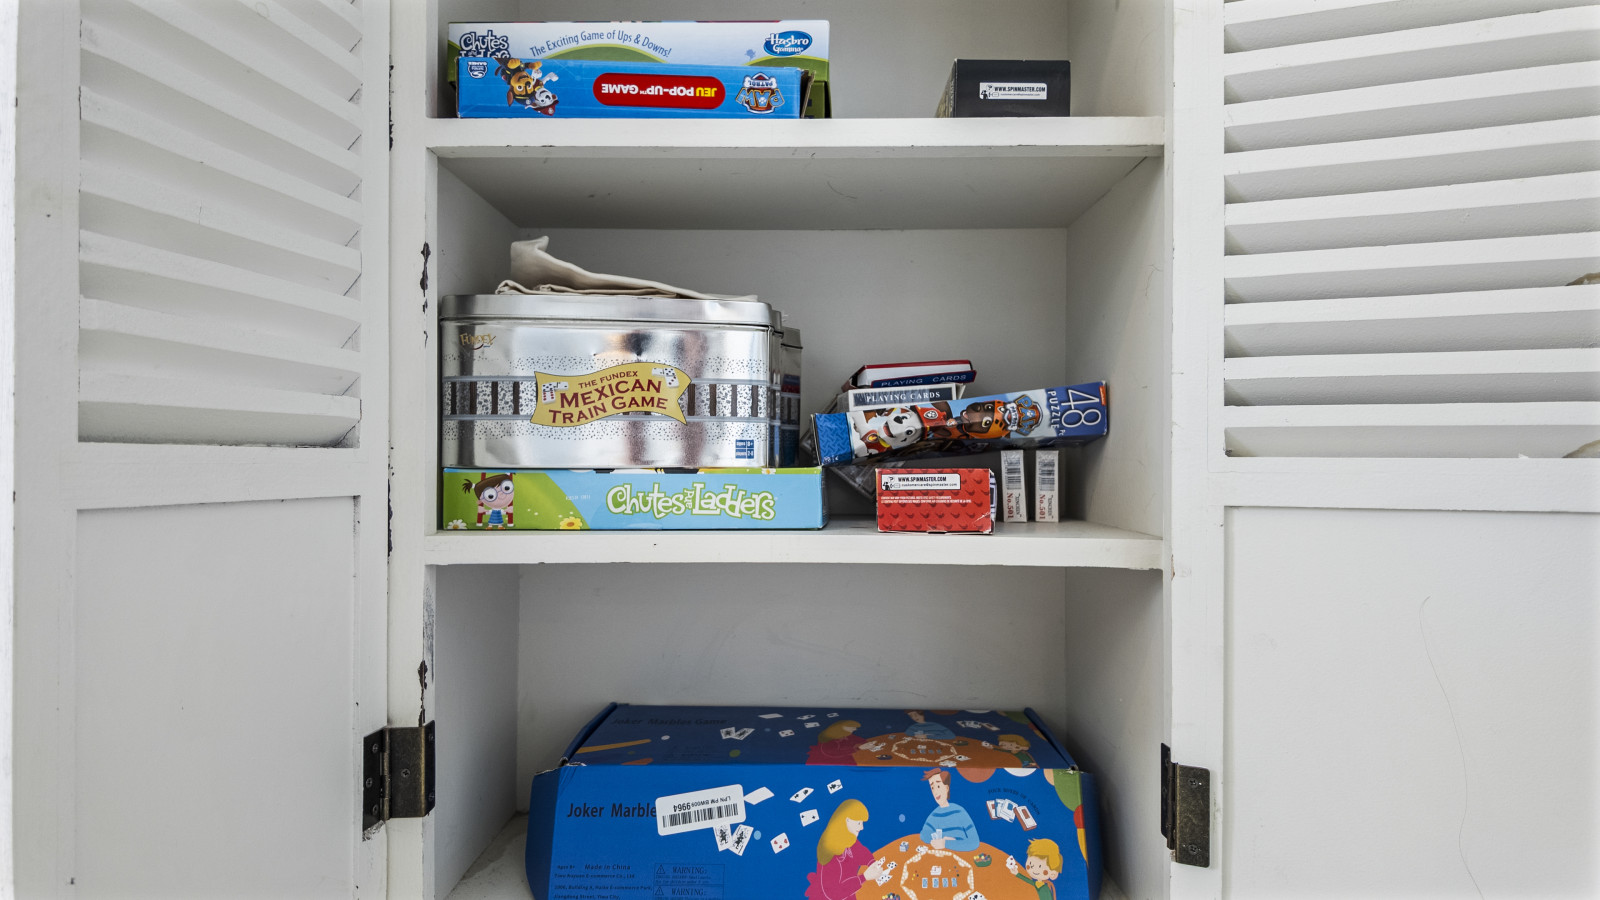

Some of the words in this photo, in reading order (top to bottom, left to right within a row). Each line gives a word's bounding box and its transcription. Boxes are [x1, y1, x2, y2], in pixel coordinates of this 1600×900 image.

[460, 30, 509, 52] Chutes
[530, 46, 546, 58] The
[546, 35, 579, 50] Exciting
[580, 31, 604, 41] Game
[606, 30, 616, 39] of
[618, 30, 632, 42] Ups
[634, 34, 640, 44] &
[642, 36, 672, 58] Downs!
[765, 33, 809, 47] Hasbro
[601, 83, 637, 94] GAME
[696, 87, 717, 97] JEU
[735, 88, 785, 107] PAW
[578, 380, 597, 389] THE
[600, 371, 638, 383] FUNDEX
[881, 378, 922, 387] PLAYING
[560, 379, 661, 408] MEXICAN
[866, 392, 907, 402] PLAYING
[911, 391, 940, 399] CARDS
[549, 403, 607, 424] TRAIN
[611, 396, 668, 410] GAME
[1009, 405, 1018, 427] PATROL
[1015, 395, 1036, 436] PAW
[1048, 391, 1060, 429] PUZZLE
[1061, 390, 1101, 428] 48
[607, 483, 685, 519] Chutes
[684, 489, 694, 509] and
[693, 483, 775, 520] Ladders
[567, 803, 604, 817] Joker
[611, 802, 656, 817] Marble
